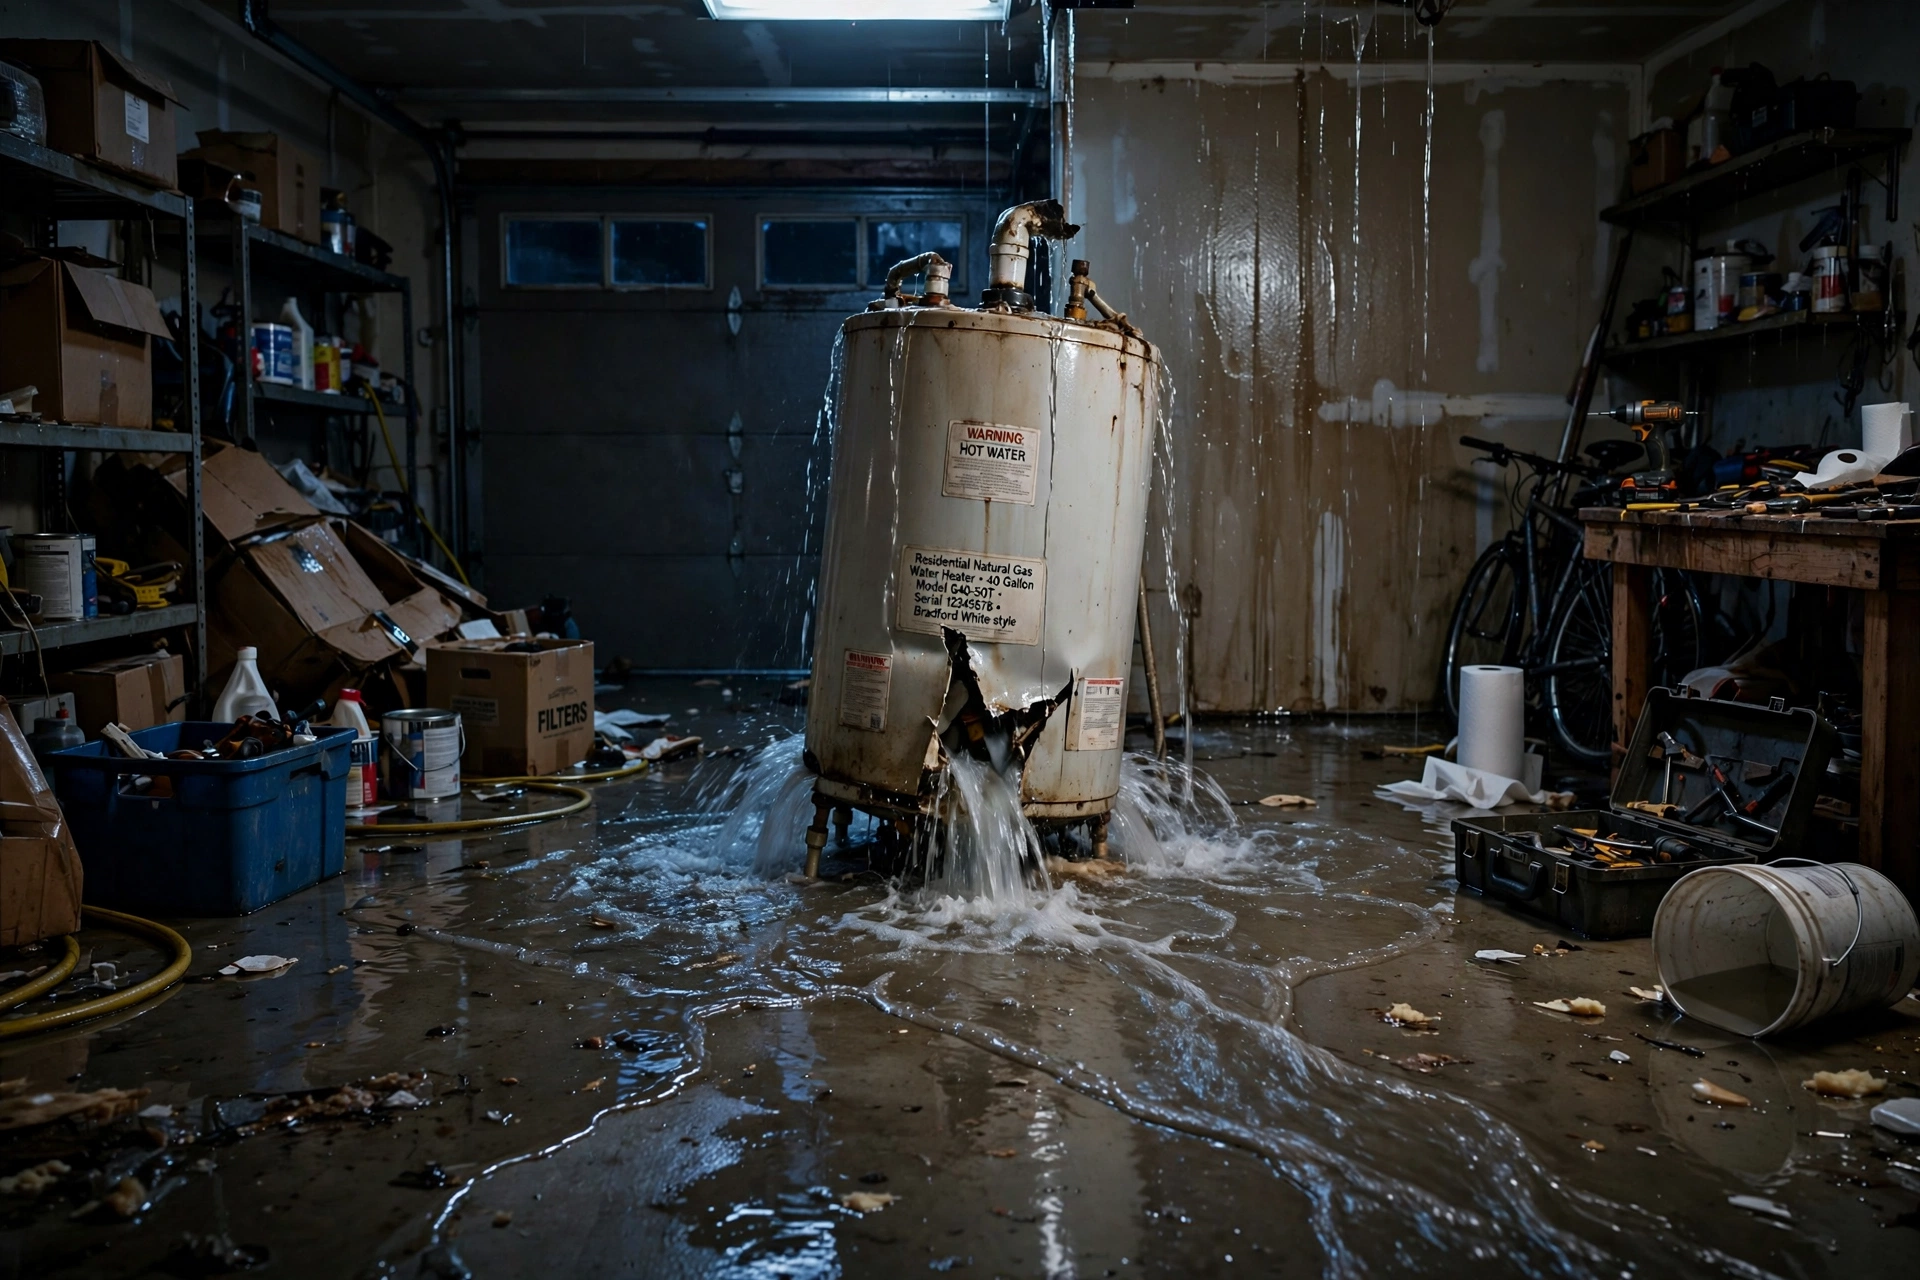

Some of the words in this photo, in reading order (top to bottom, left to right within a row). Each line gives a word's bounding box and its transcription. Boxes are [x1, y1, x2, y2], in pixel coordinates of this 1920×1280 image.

[967, 427, 1024, 445] WARNING
[960, 442, 984, 457] HOT
[987, 446, 1026, 462] WATER
[915, 553, 971, 570] Residential
[974, 559, 1011, 574] Natural
[1013, 564, 1033, 577] Gas
[910, 565, 938, 578] Water
[942, 569, 975, 583] Heater
[986, 575, 1000, 586] 40
[1003, 576, 1034, 590] Gallon
[916, 579, 947, 593] Model
[915, 592, 942, 606] Serial
[914, 605, 958, 621] Bradford
[961, 611, 991, 626] White
[993, 614, 1016, 629] style
[538, 701, 588, 733] FILTERS
